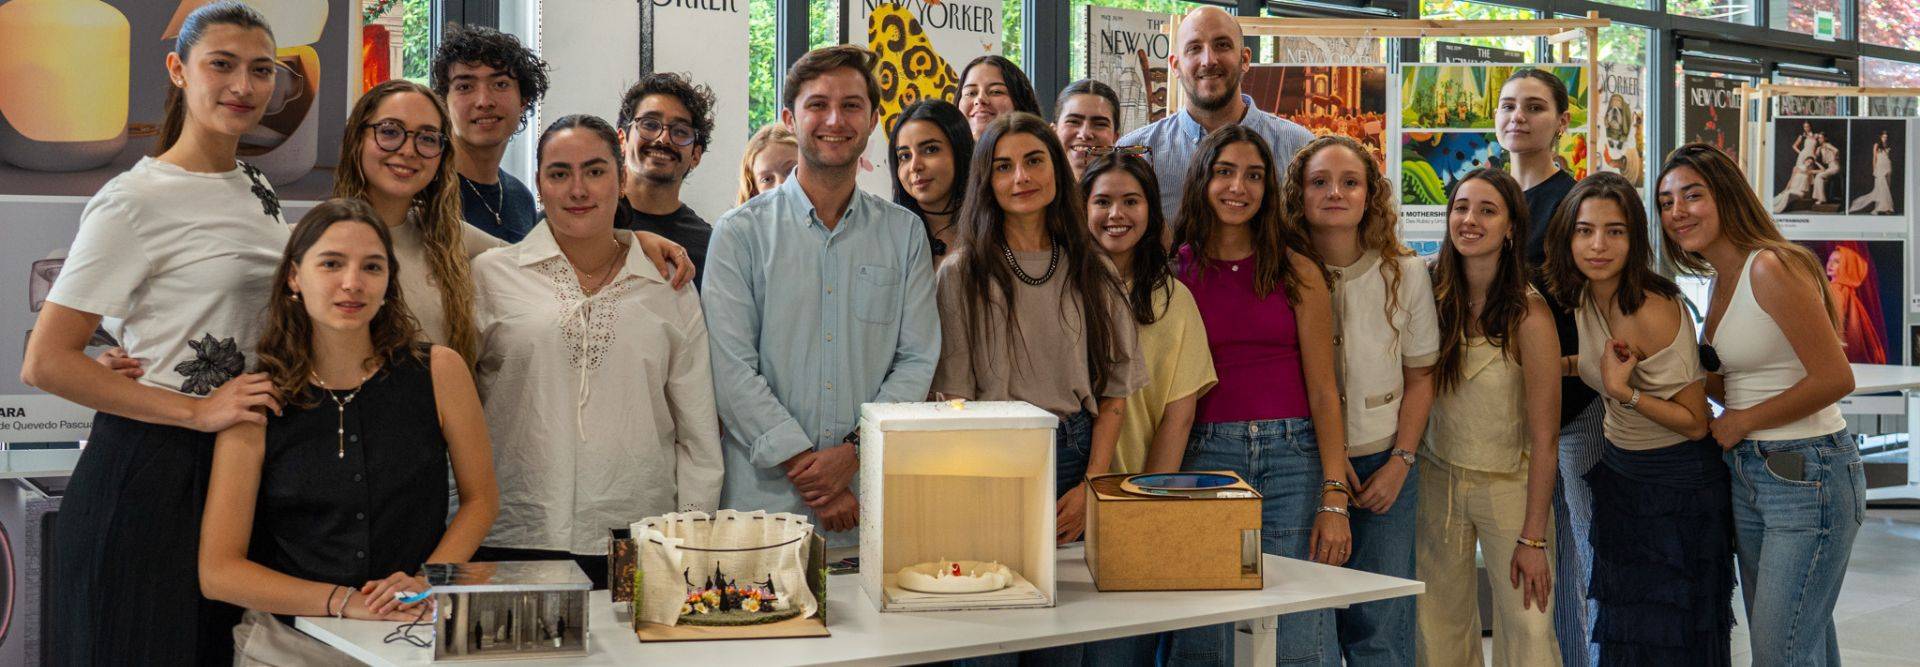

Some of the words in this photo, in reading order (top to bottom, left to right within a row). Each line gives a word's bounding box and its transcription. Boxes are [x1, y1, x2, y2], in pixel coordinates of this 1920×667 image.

[915, 0, 995, 34] YORKER
[1101, 29, 1141, 55] NEW
[1478, 48, 1491, 59] THE
[1691, 87, 1711, 107] NEW
[13, 421, 58, 431] Quevedo
